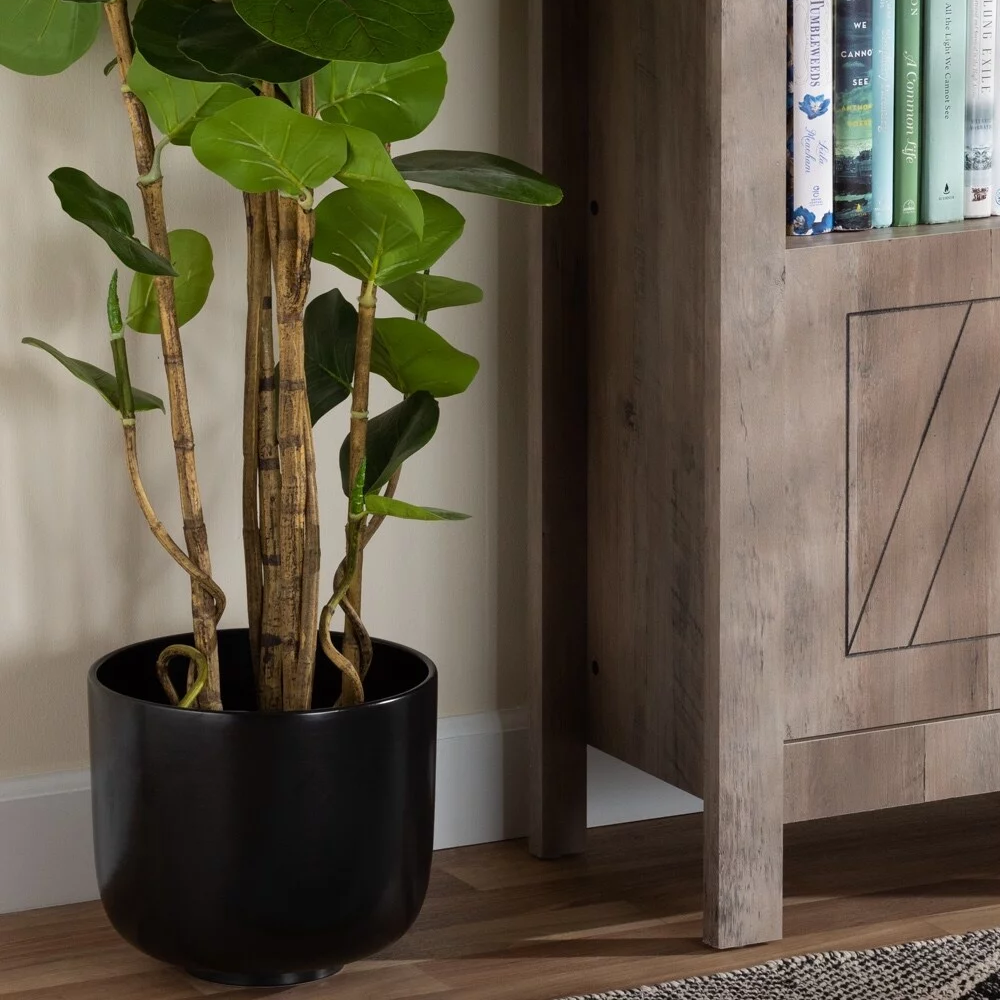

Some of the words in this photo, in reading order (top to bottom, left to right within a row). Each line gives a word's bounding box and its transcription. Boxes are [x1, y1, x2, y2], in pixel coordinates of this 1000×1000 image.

[853, 21, 867, 29] WE
[840, 48, 873, 58] CANNO
[943, 32, 952, 55] Light
[902, 51, 917, 67] A
[944, 56, 952, 70] We
[981, 48, 992, 93] EXILE
[852, 77, 869, 86] SEE
[944, 72, 952, 103] Cannot
[906, 71, 917, 135] Common
[801, 126, 817, 173] Meacham
[816, 141, 829, 167] Leila
[901, 137, 917, 164] Life
